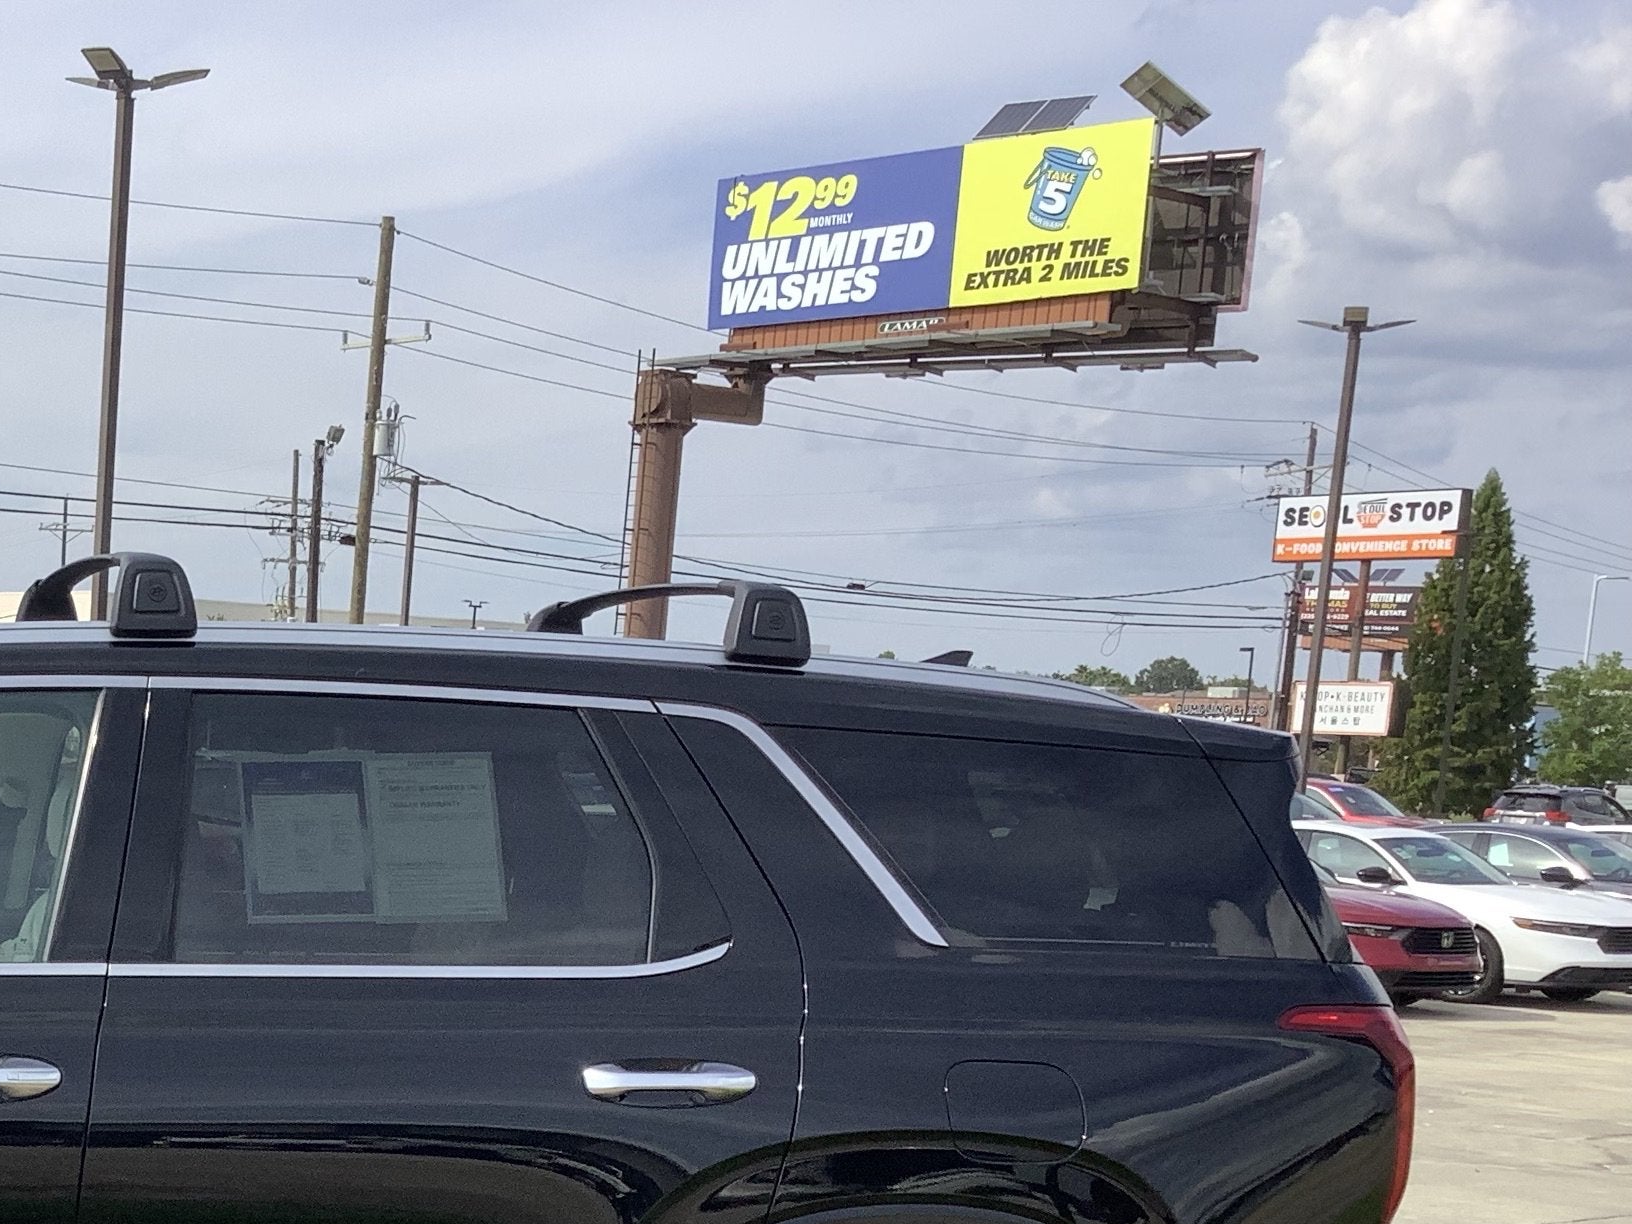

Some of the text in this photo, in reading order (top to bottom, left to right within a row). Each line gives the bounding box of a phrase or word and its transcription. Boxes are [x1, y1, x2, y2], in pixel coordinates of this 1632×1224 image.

[1046, 170, 1077, 184] TAKE
[1038, 180, 1073, 215] 5
[810, 212, 853, 228] MONTHLY
[722, 221, 935, 280] UNLIMITED
[985, 237, 1111, 268] WORTH THE
[964, 257, 1130, 291] EXTRA 2 MILES
[720, 265, 880, 316] WASHES
[1283, 501, 1453, 528] SEOL STOP
[1335, 539, 1407, 553] ONVENIENCE
[1411, 539, 1453, 551] STORE
[1318, 705, 1344, 713] NCHAN
